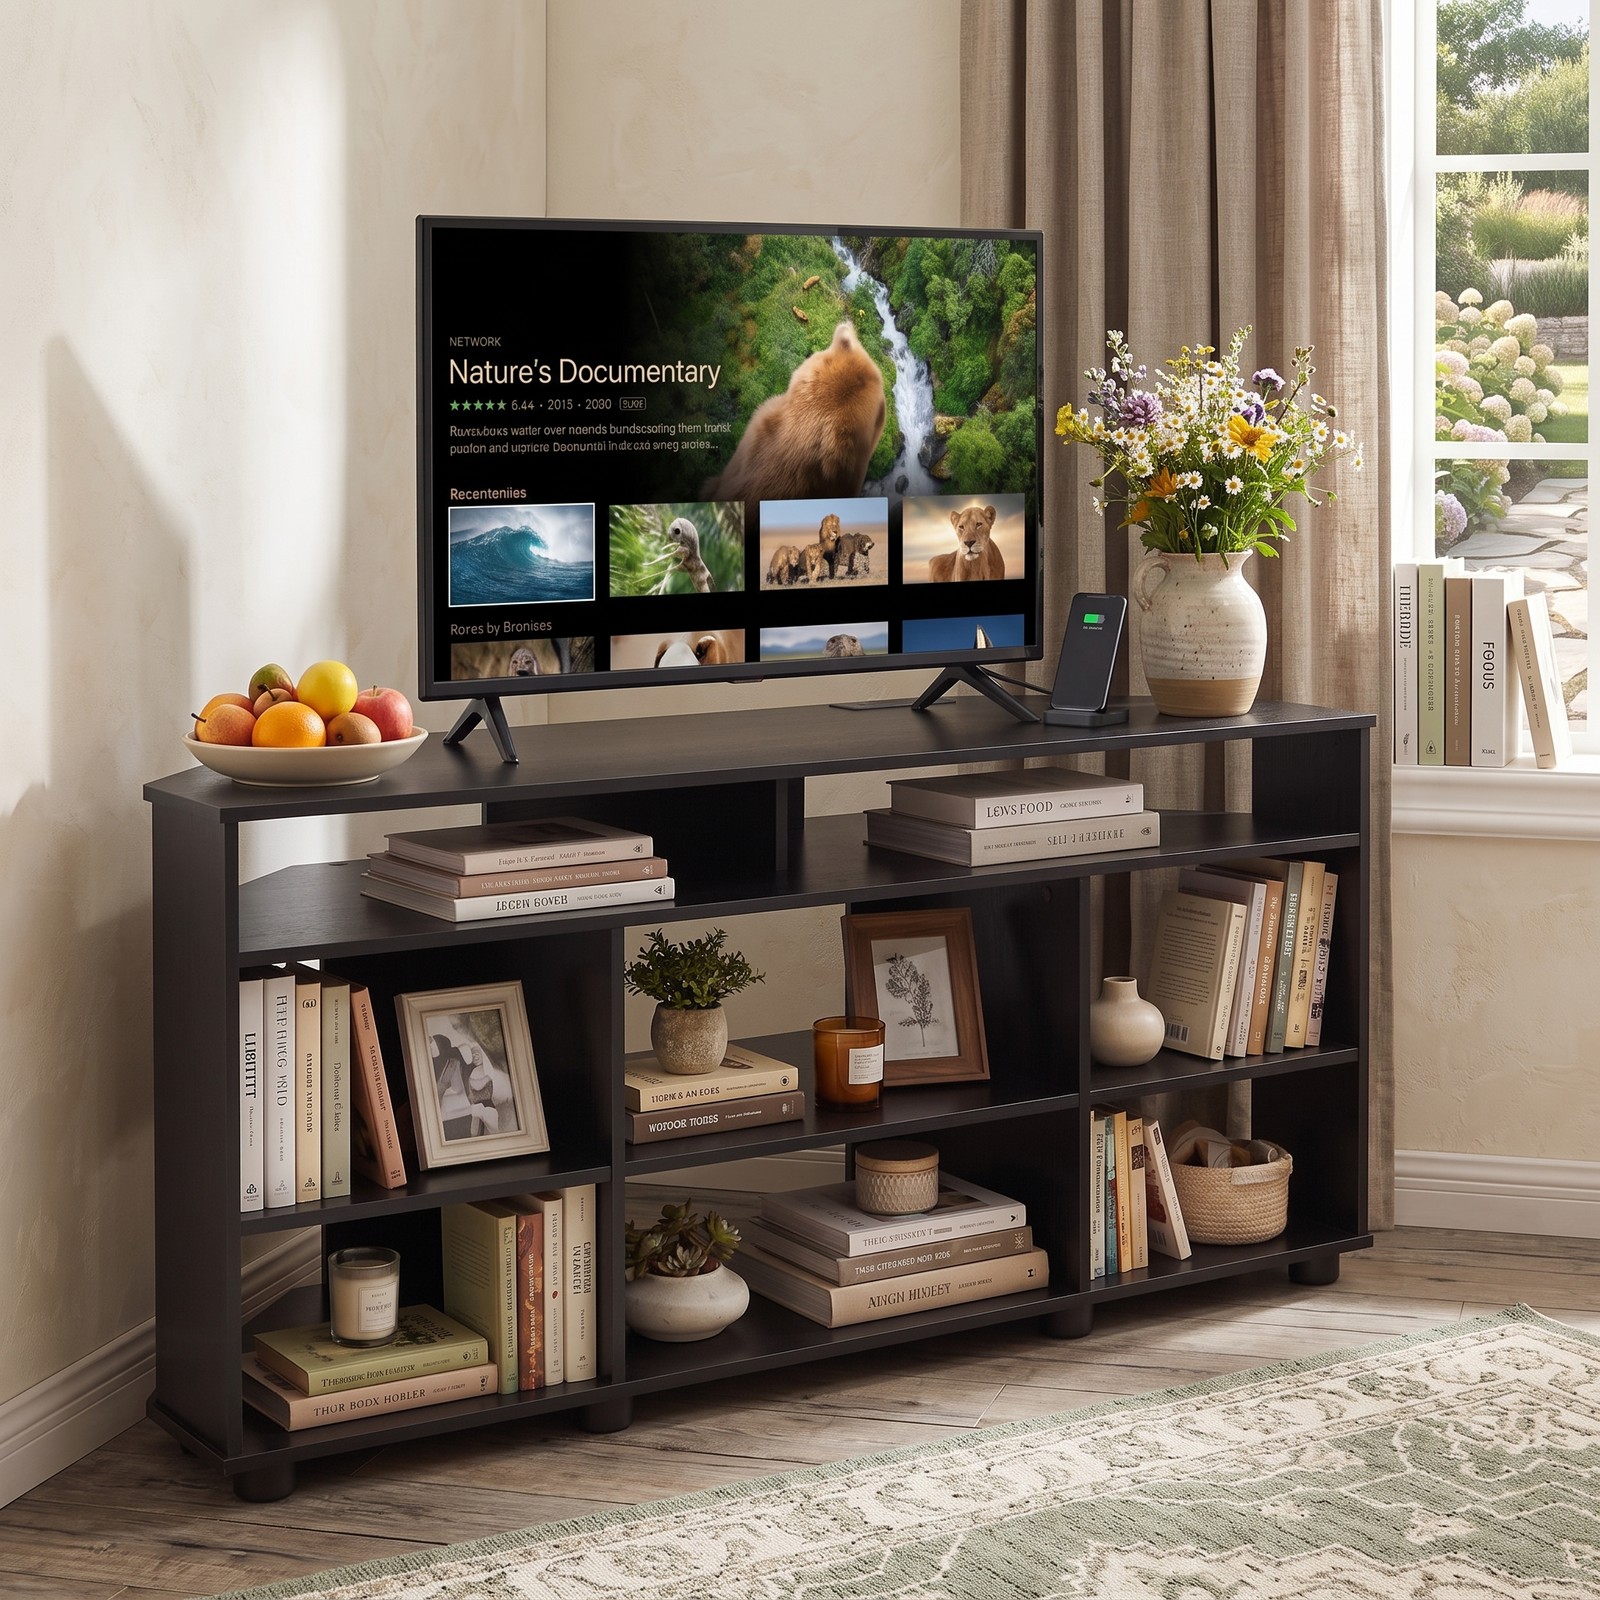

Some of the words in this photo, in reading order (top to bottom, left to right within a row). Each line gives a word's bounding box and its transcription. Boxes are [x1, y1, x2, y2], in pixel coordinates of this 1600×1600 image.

[449, 336, 502, 348] NETWORK
[559, 358, 721, 389] Documentary
[547, 398, 573, 410] 2015
[543, 426, 567, 436] over
[488, 441, 509, 453] and
[486, 621, 501, 636] by
[1019, 800, 1053, 815] FOOD
[685, 1089, 698, 1099] AN
[349, 1396, 380, 1411] BODX
[383, 1388, 426, 1404] HOBLER
